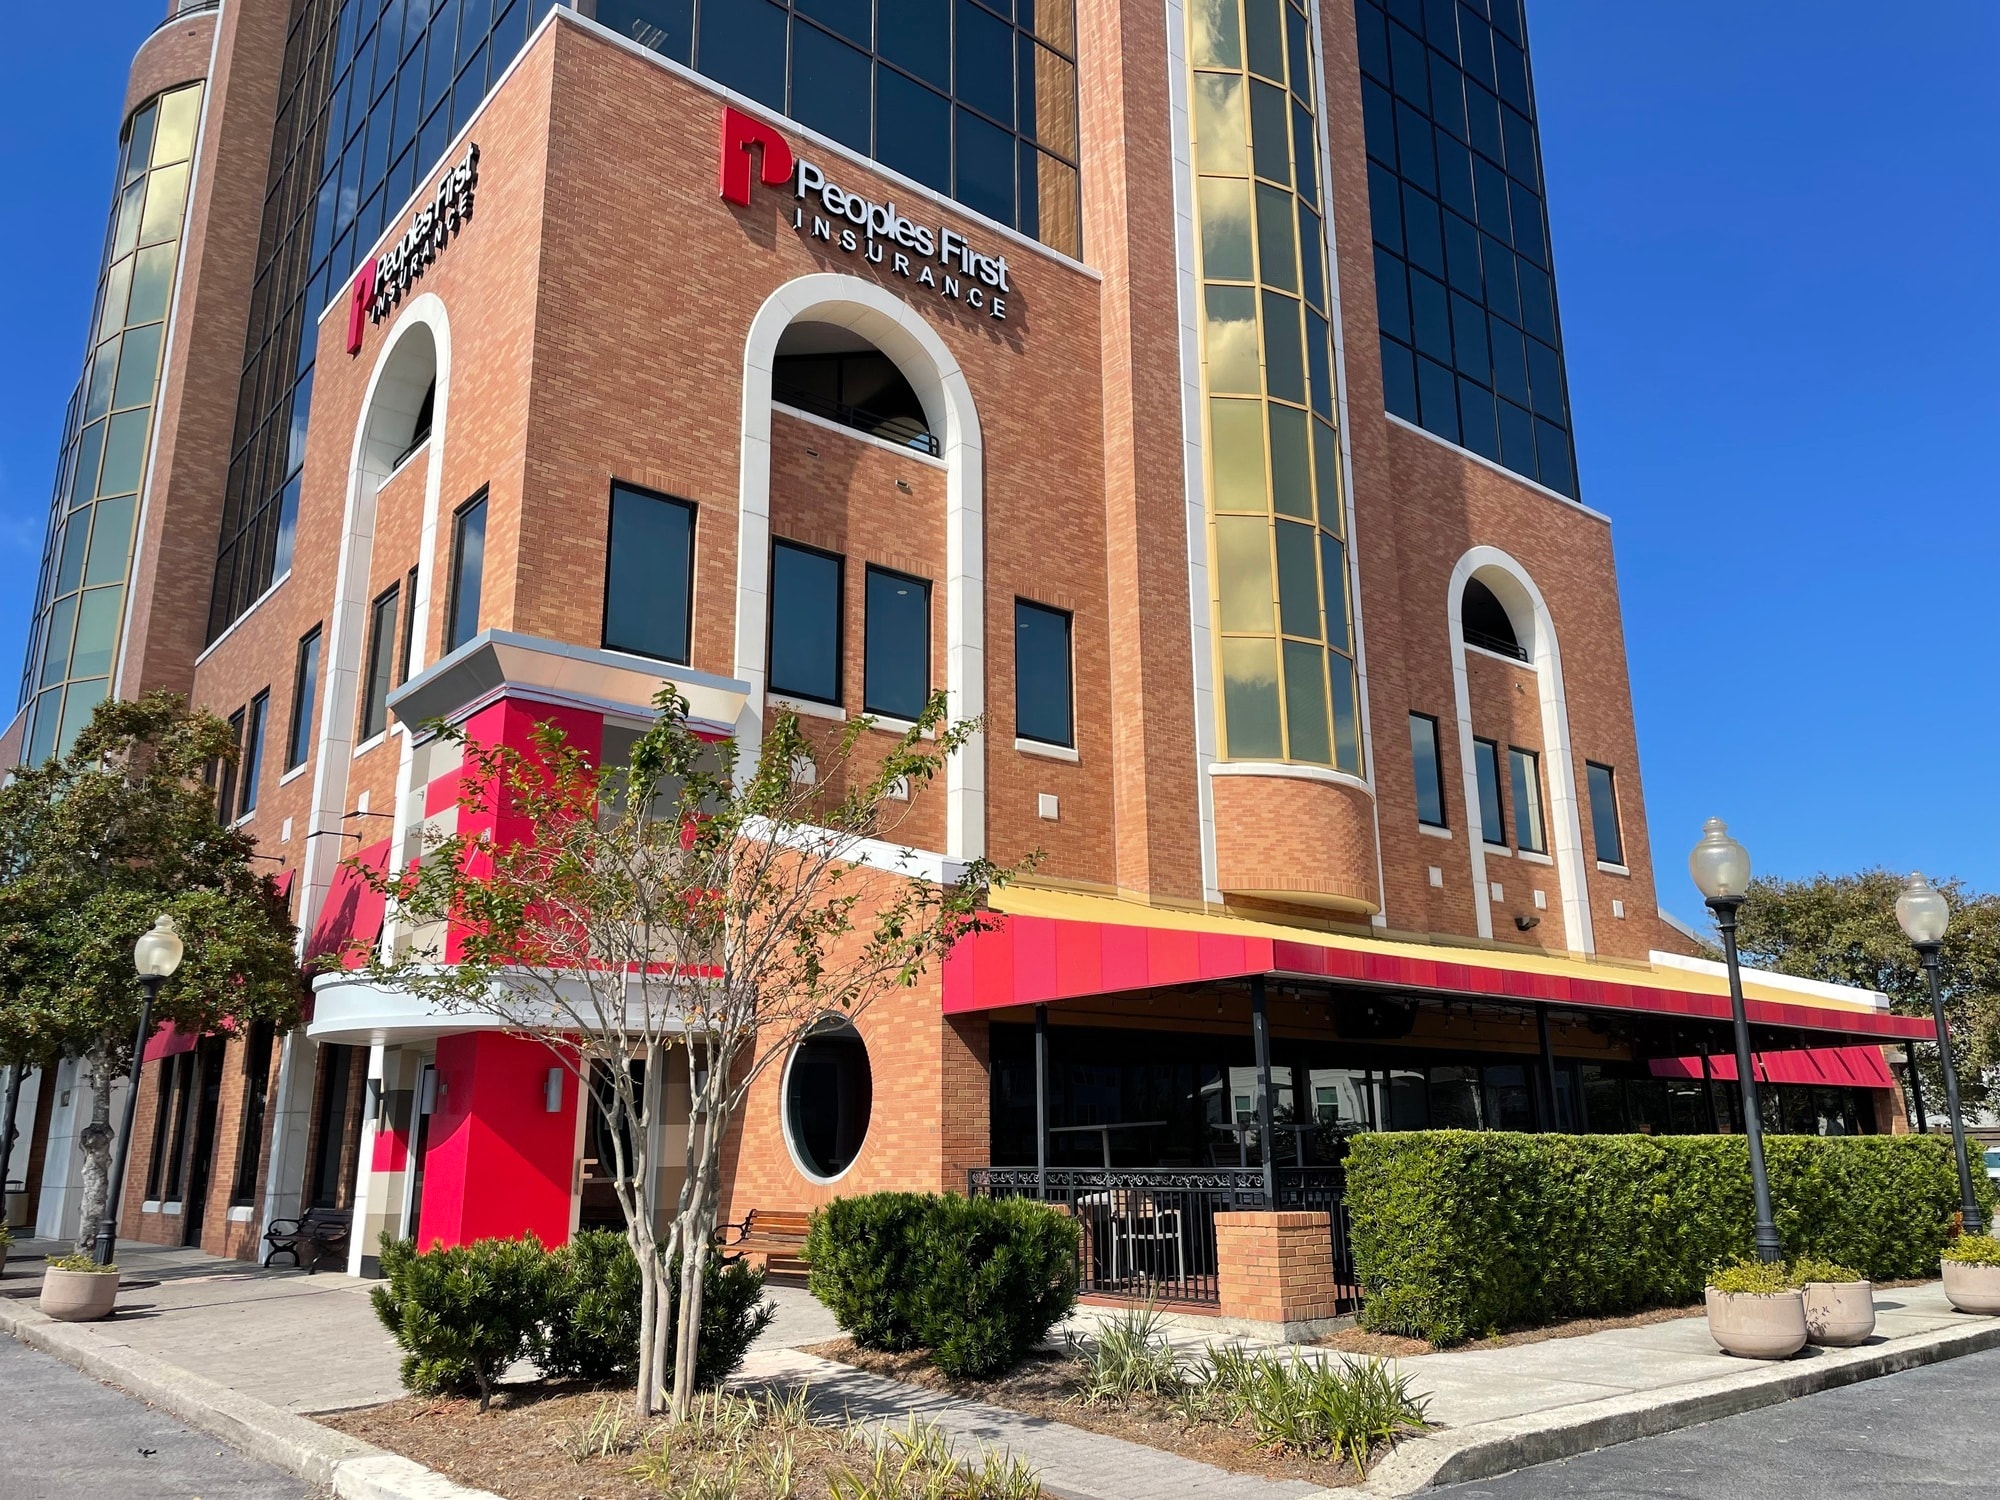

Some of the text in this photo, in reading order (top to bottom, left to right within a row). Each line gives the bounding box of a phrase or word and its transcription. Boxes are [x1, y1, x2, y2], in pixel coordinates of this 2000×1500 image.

[371, 191, 470, 322] INSURANCE
[374, 143, 475, 295] Peoples First
[793, 208, 1006, 320] INSURANCE
[796, 159, 1009, 292] Peoples First
